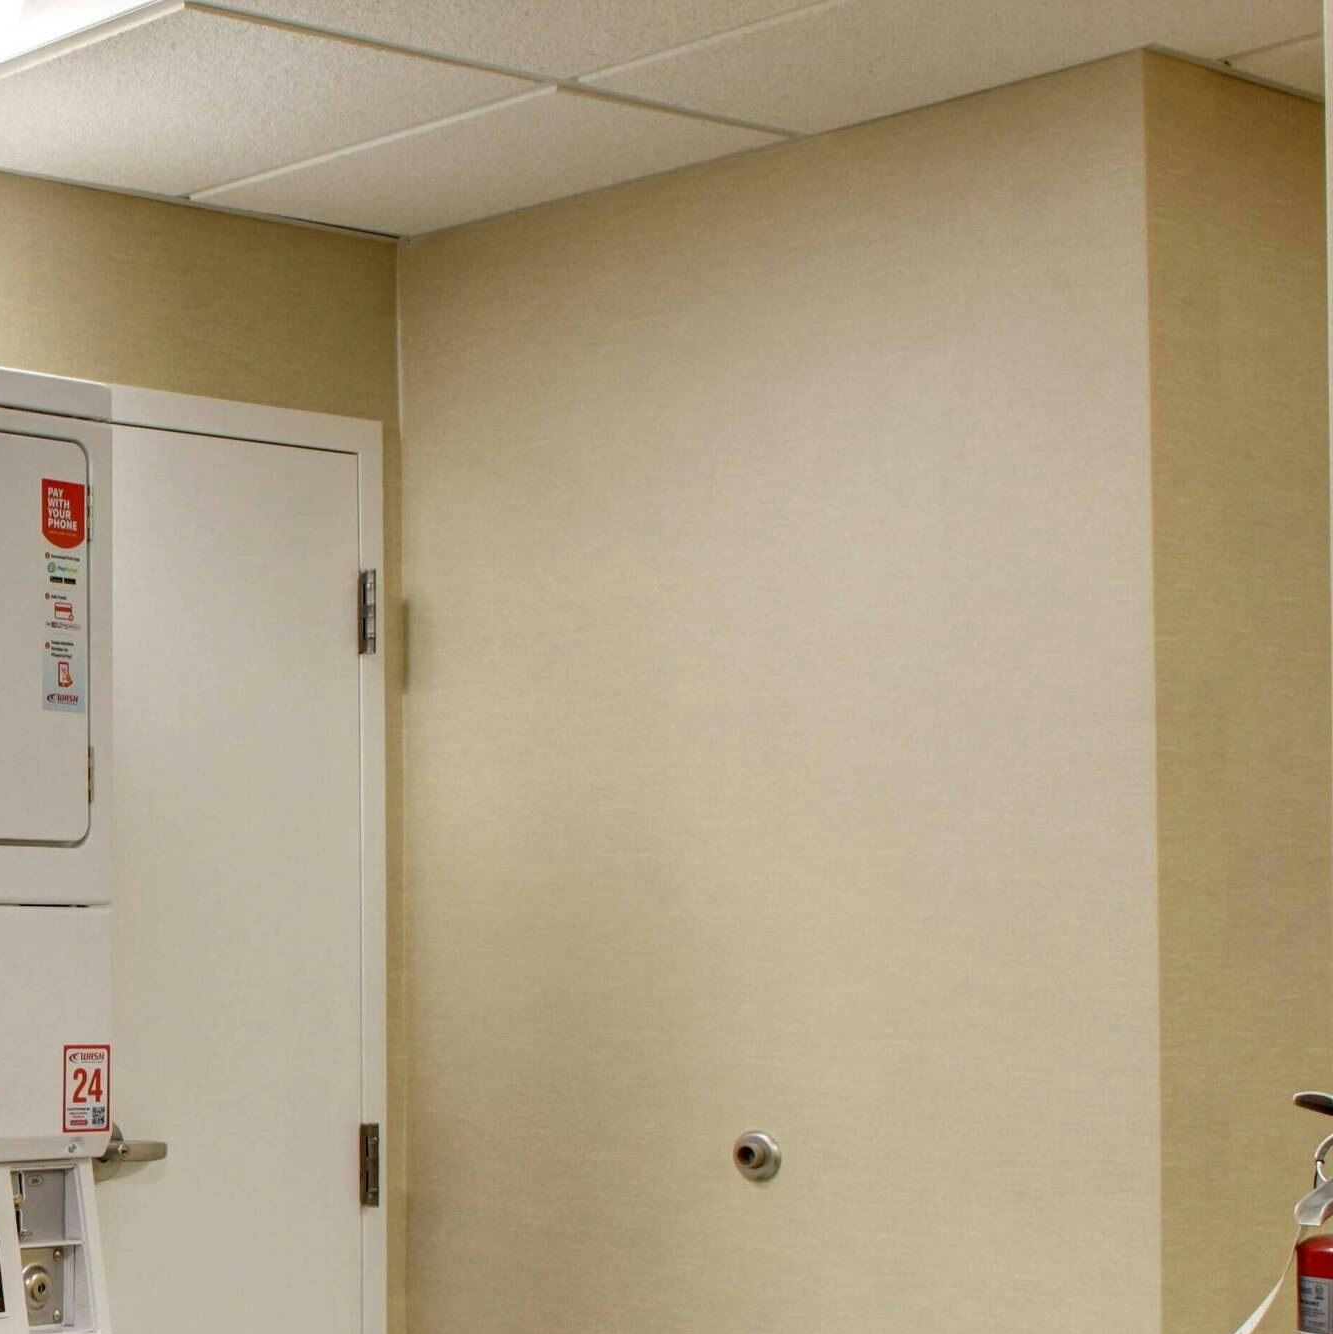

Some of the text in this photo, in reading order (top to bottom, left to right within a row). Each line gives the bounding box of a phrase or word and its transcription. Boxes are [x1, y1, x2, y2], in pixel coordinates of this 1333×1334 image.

[48, 487, 64, 498] PAY
[48, 497, 70, 509] WITH
[48, 508, 71, 520] YOUR
[48, 518, 77, 531] PHONE
[80, 1052, 104, 1061] WASH
[73, 1067, 103, 1103] 24
